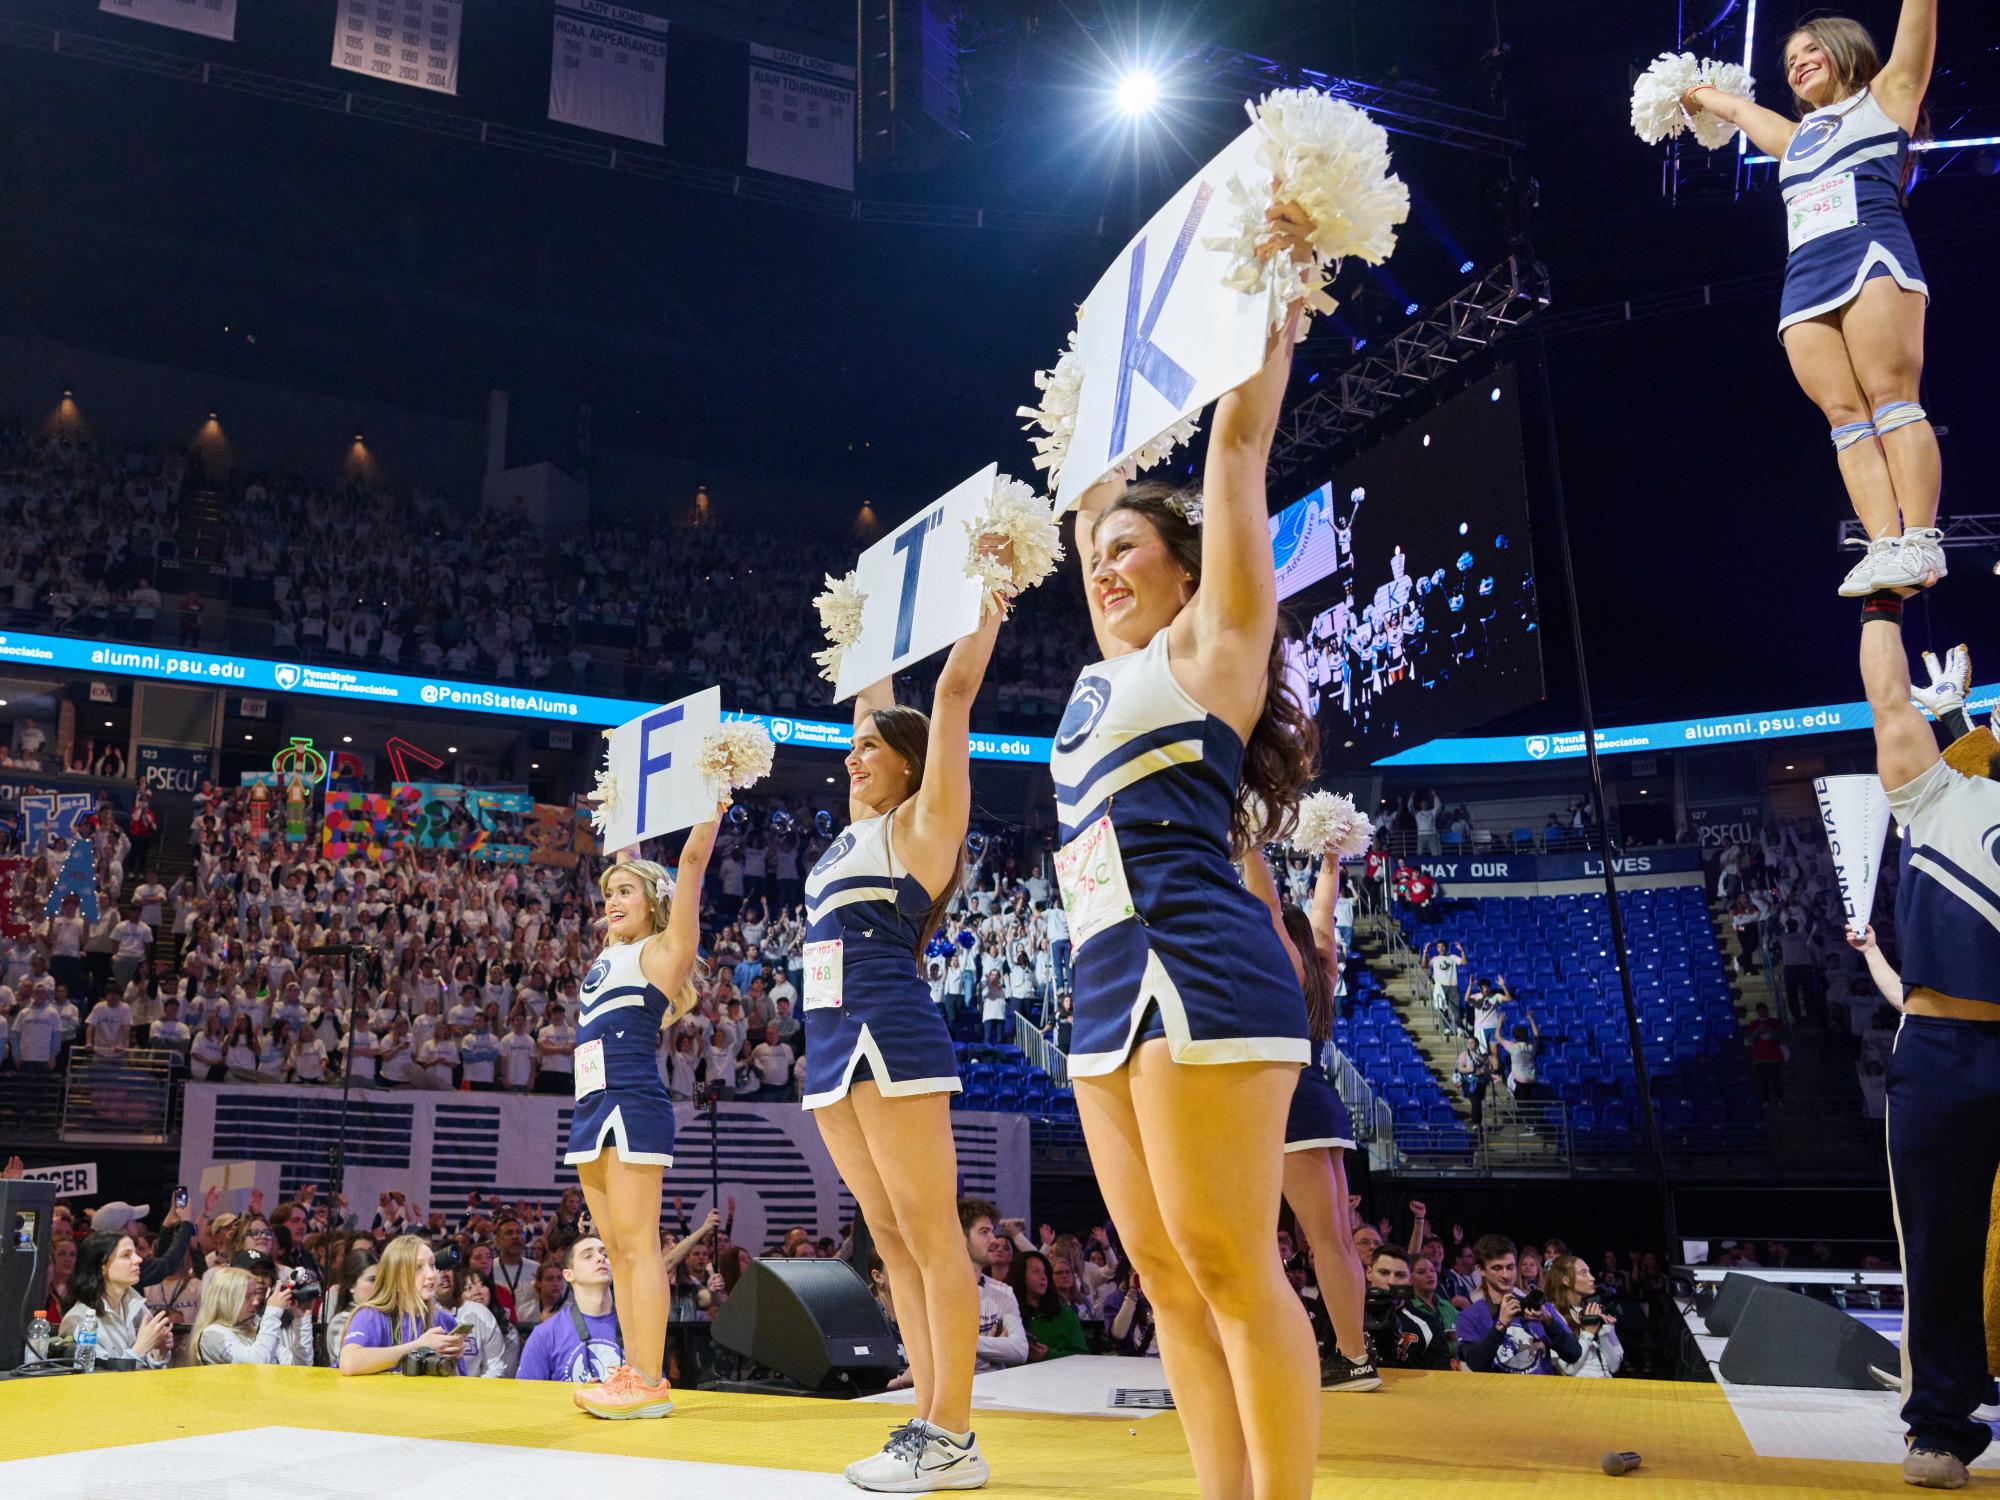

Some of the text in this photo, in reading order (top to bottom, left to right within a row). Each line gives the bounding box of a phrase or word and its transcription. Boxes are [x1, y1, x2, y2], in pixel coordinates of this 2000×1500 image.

[612, 7, 645, 24] LIONS
[557, 19, 585, 37] NCAA
[590, 28, 667, 57] APPEARANCES
[784, 78, 850, 105] TOURNAMENT
[1813, 196, 1842, 216] 95B
[1108, 181, 1214, 463] K
[1286, 513, 1315, 575] Adventure
[91, 648, 245, 679] alumni.psu.edu
[303, 668, 357, 683] PennState
[302, 678, 399, 697] Alumni Association
[420, 685, 578, 716] @PennStateAlums
[794, 722, 840, 735] PennState
[1685, 711, 1840, 741] alumni.psu.edu
[794, 731, 826, 742] Alumni
[1552, 733, 1605, 746] PennSte
[1553, 743, 1587, 753] Alumn
[146, 766, 198, 792] PSECU
[636, 704, 685, 835] F
[1421, 864, 1458, 878] MAY
[1470, 863, 1508, 877] OUR
[811, 966, 832, 981] 76B
[581, 1060, 598, 1076] 76A
[1350, 1364, 1374, 1377] HOKA
